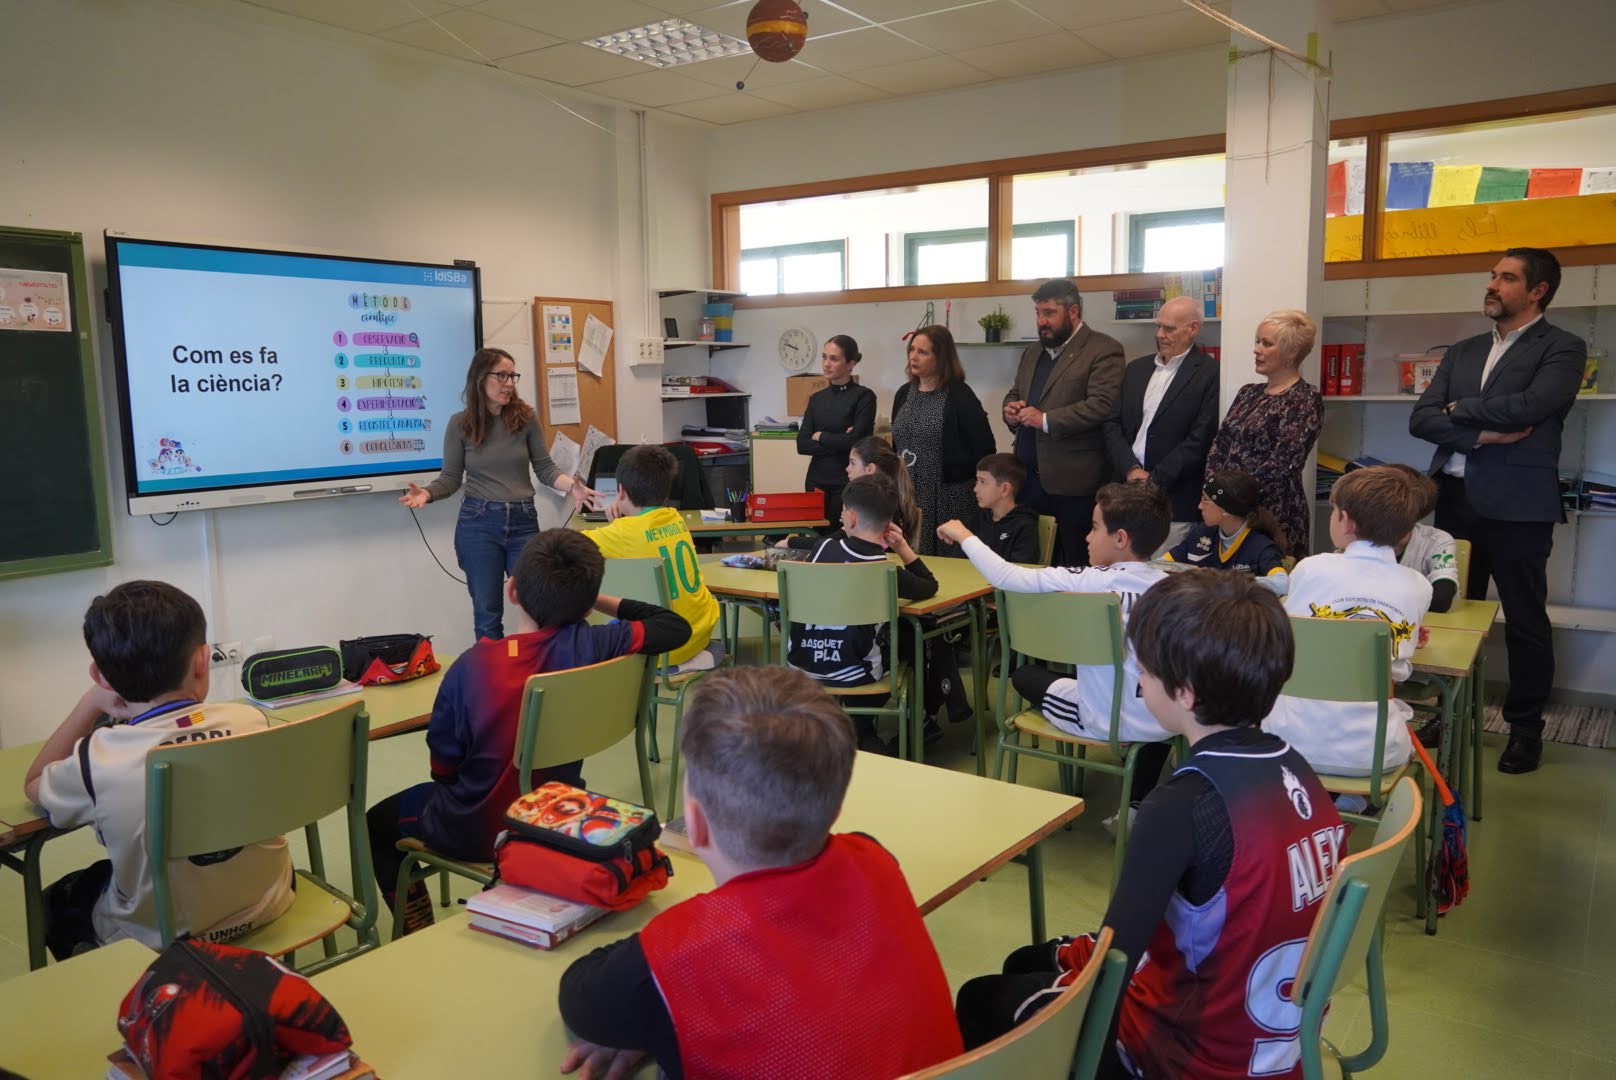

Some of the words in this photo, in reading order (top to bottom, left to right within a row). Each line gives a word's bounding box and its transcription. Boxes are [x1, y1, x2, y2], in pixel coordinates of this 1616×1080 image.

[172, 344, 224, 364] Com
[229, 350, 254, 364] es
[259, 346, 279, 364] fa
[338, 356, 345, 366] 2
[171, 374, 190, 393] la
[197, 373, 283, 393] ciència?
[340, 378, 346, 388] 3
[342, 421, 349, 431] 5
[344, 442, 350, 452] 6
[658, 539, 701, 600] 10
[800, 638, 844, 649] BASQUET
[813, 649, 842, 663] PLA
[260, 663, 334, 687] MINECRAFT
